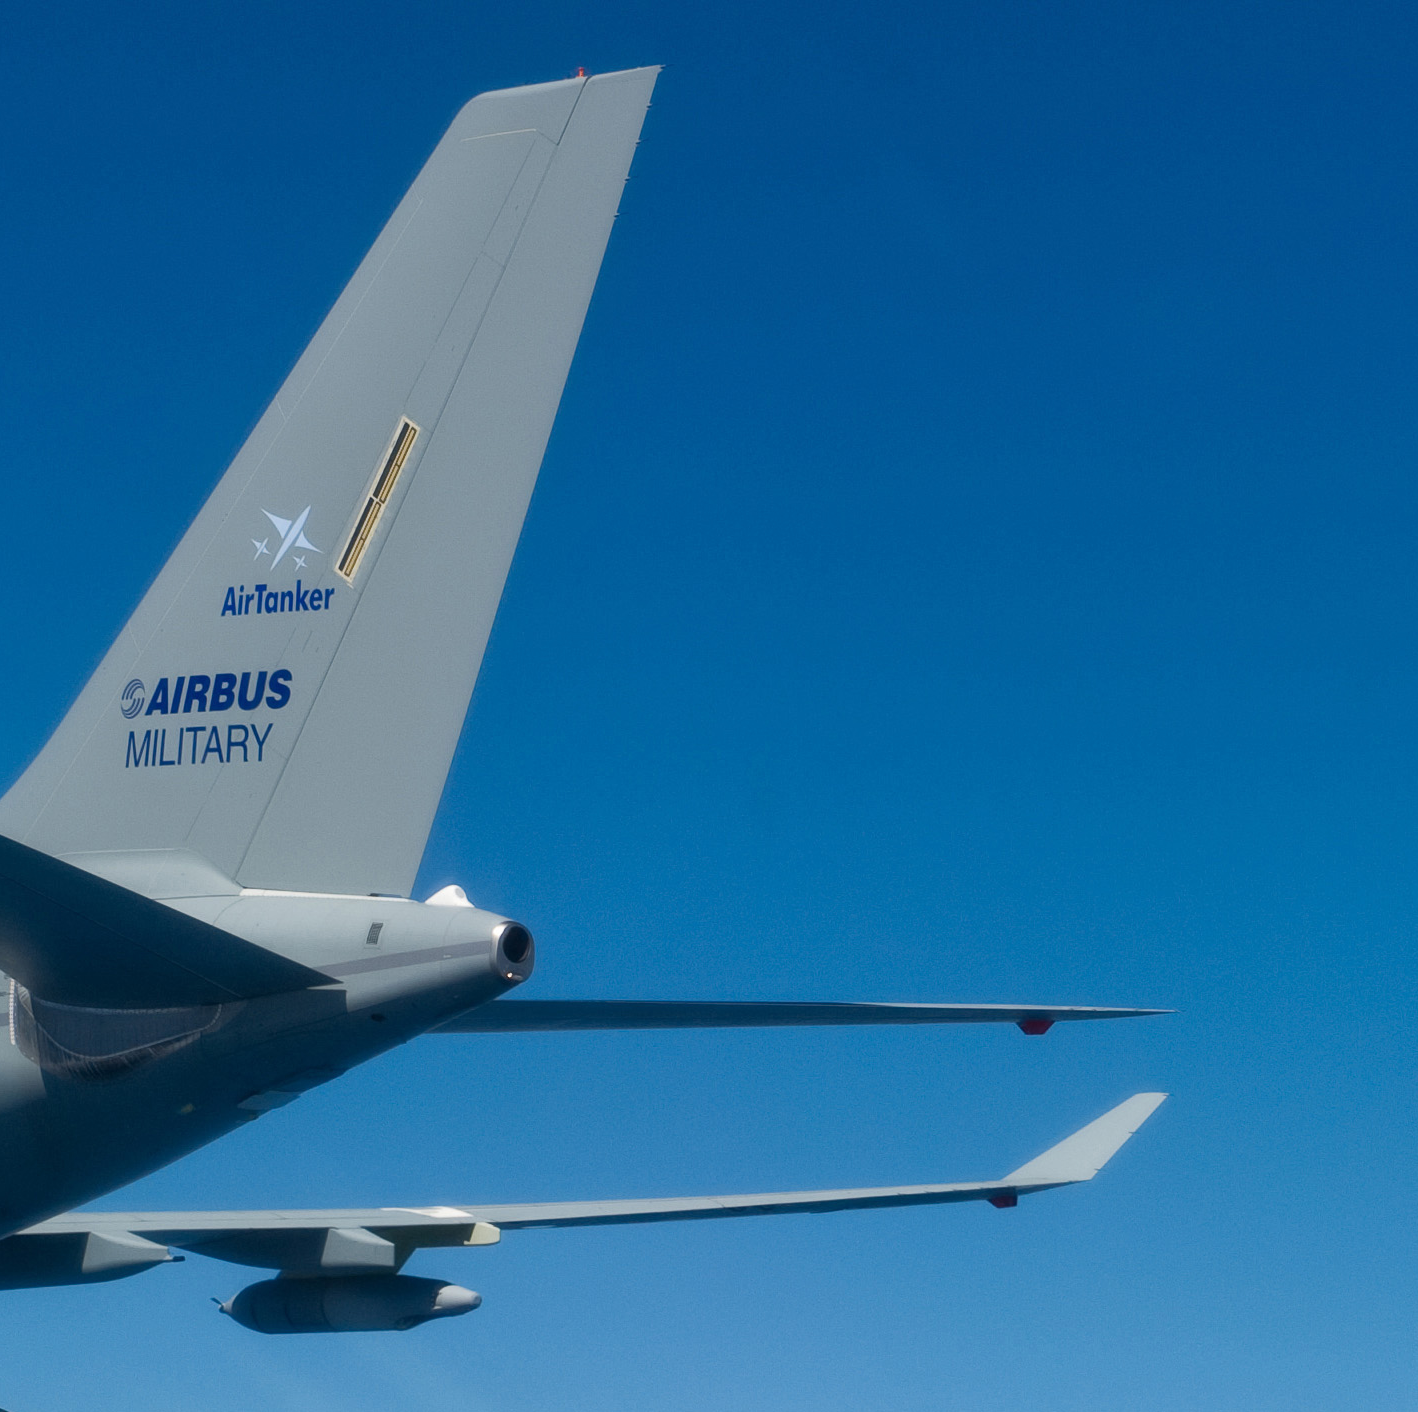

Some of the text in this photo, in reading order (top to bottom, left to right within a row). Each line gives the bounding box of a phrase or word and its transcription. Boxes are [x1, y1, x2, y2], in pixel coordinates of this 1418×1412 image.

[221, 579, 335, 617] AirTanker
[144, 668, 293, 717] AIRBUS
[125, 722, 274, 769] MILITARY
